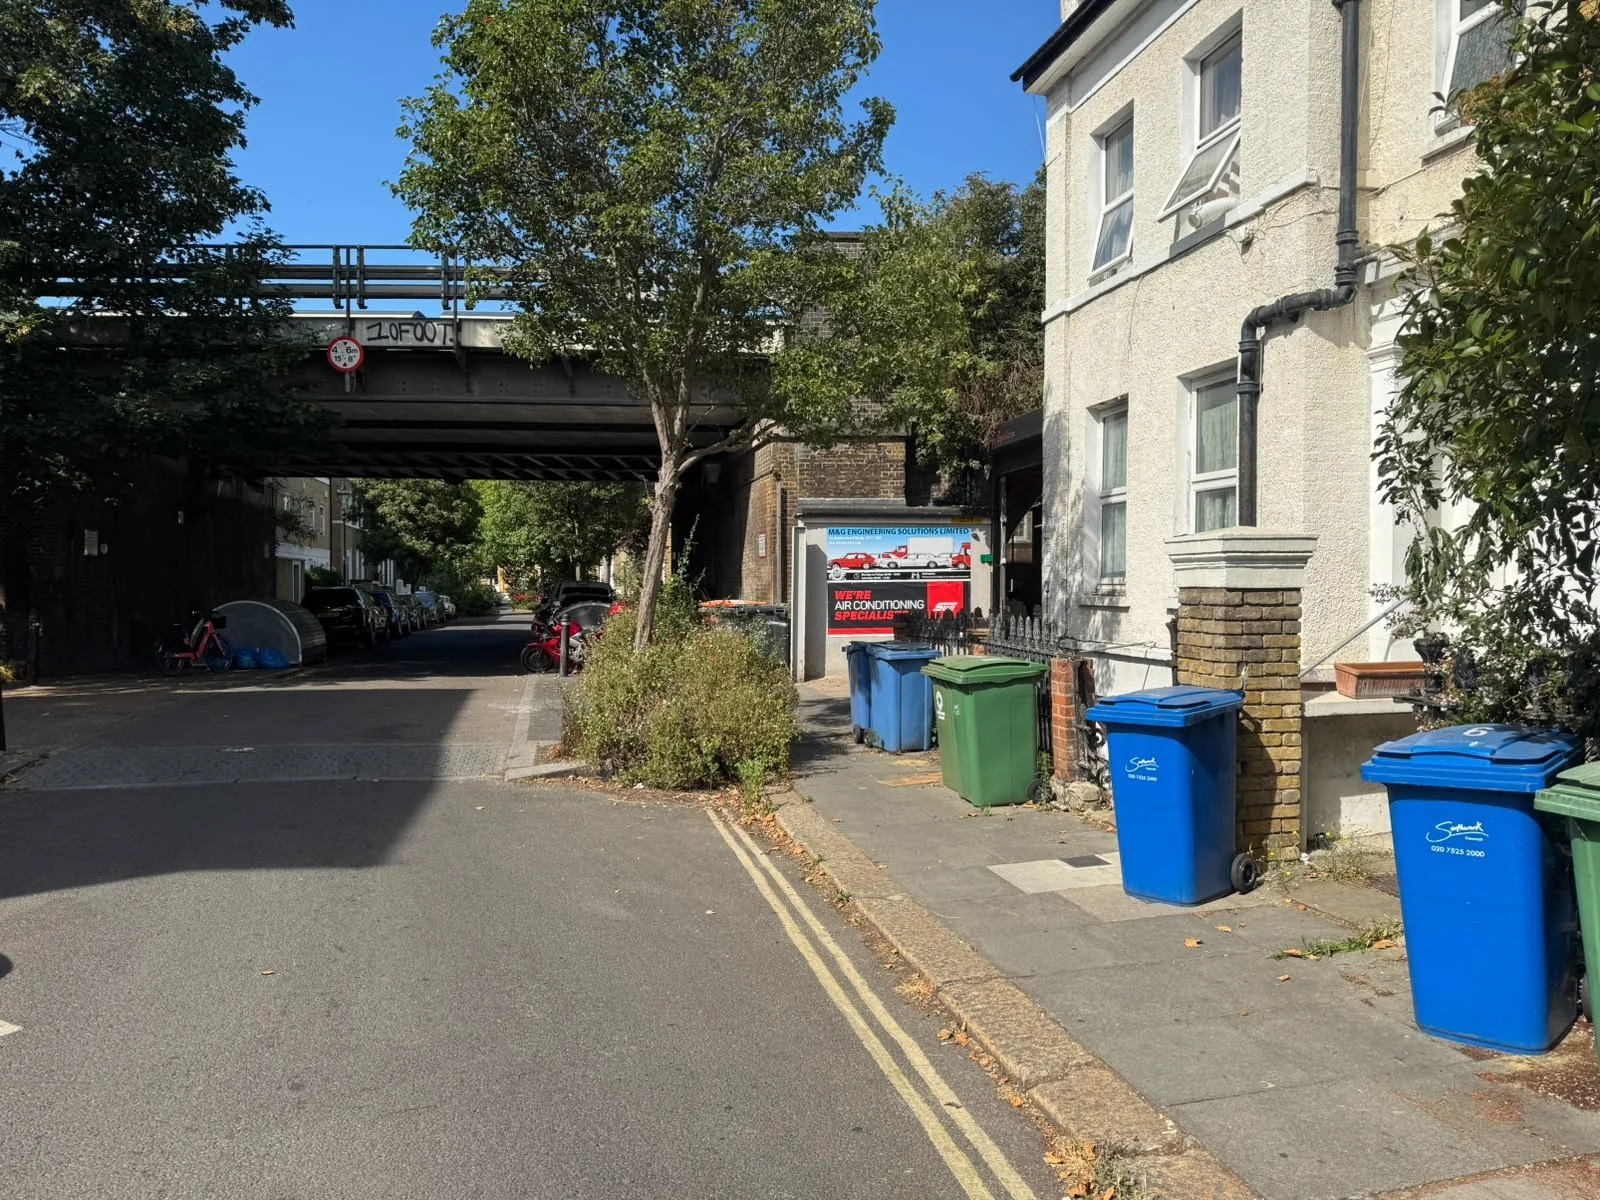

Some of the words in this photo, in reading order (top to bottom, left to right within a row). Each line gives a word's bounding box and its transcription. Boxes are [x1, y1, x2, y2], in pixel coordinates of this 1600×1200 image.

[828, 528, 846, 536] M&G
[847, 528, 897, 536] ENGINEERING
[939, 527, 969, 535] LIMITED
[834, 590, 872, 600] WE'RE
[834, 600, 852, 611] AIR
[853, 599, 925, 610] CONDITIONING
[1431, 845, 1445, 853] 020
[1446, 846, 1465, 855] 7525
[1465, 849, 1486, 858] 2000
